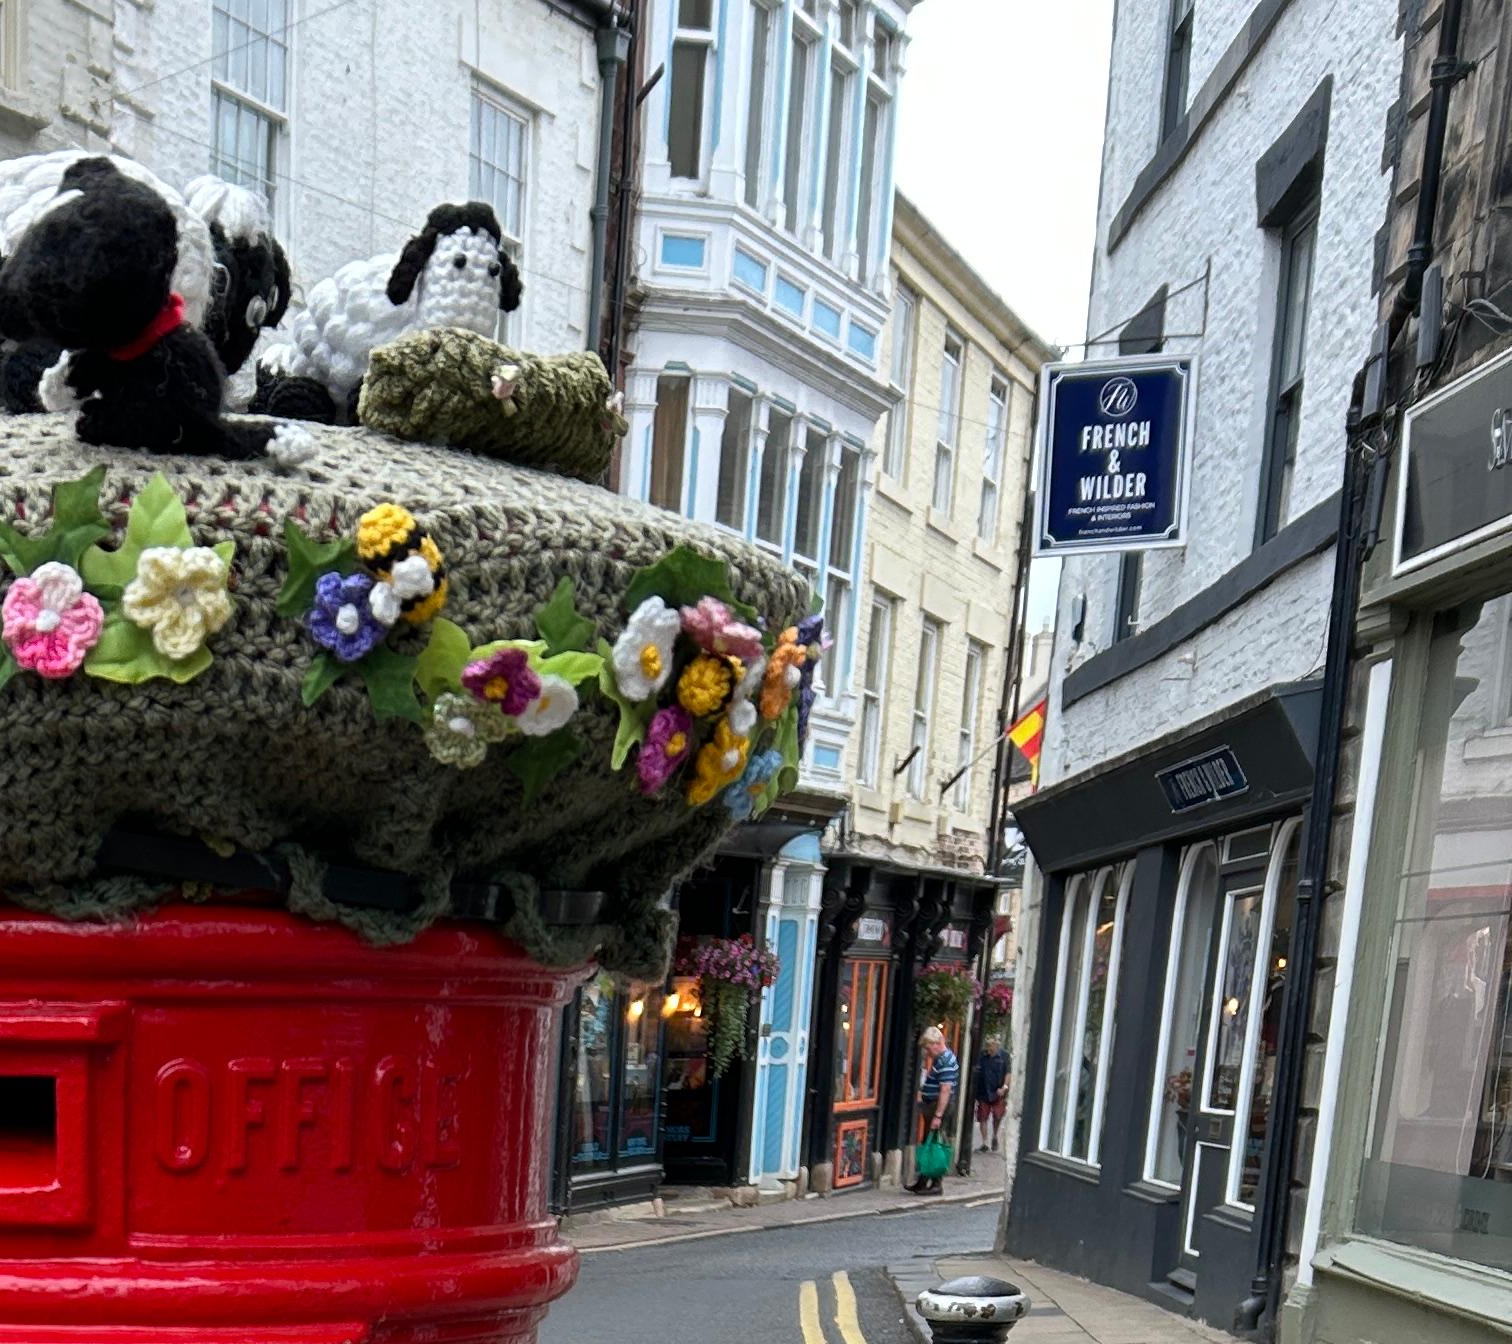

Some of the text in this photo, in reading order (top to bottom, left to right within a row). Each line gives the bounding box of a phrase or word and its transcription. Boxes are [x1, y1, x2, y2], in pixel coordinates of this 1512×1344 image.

[1081, 420, 1151, 450] FRENCH
[1107, 449, 1121, 473] &
[1080, 472, 1147, 501] WILDER
[153, 1055, 472, 1177] OFFICE
